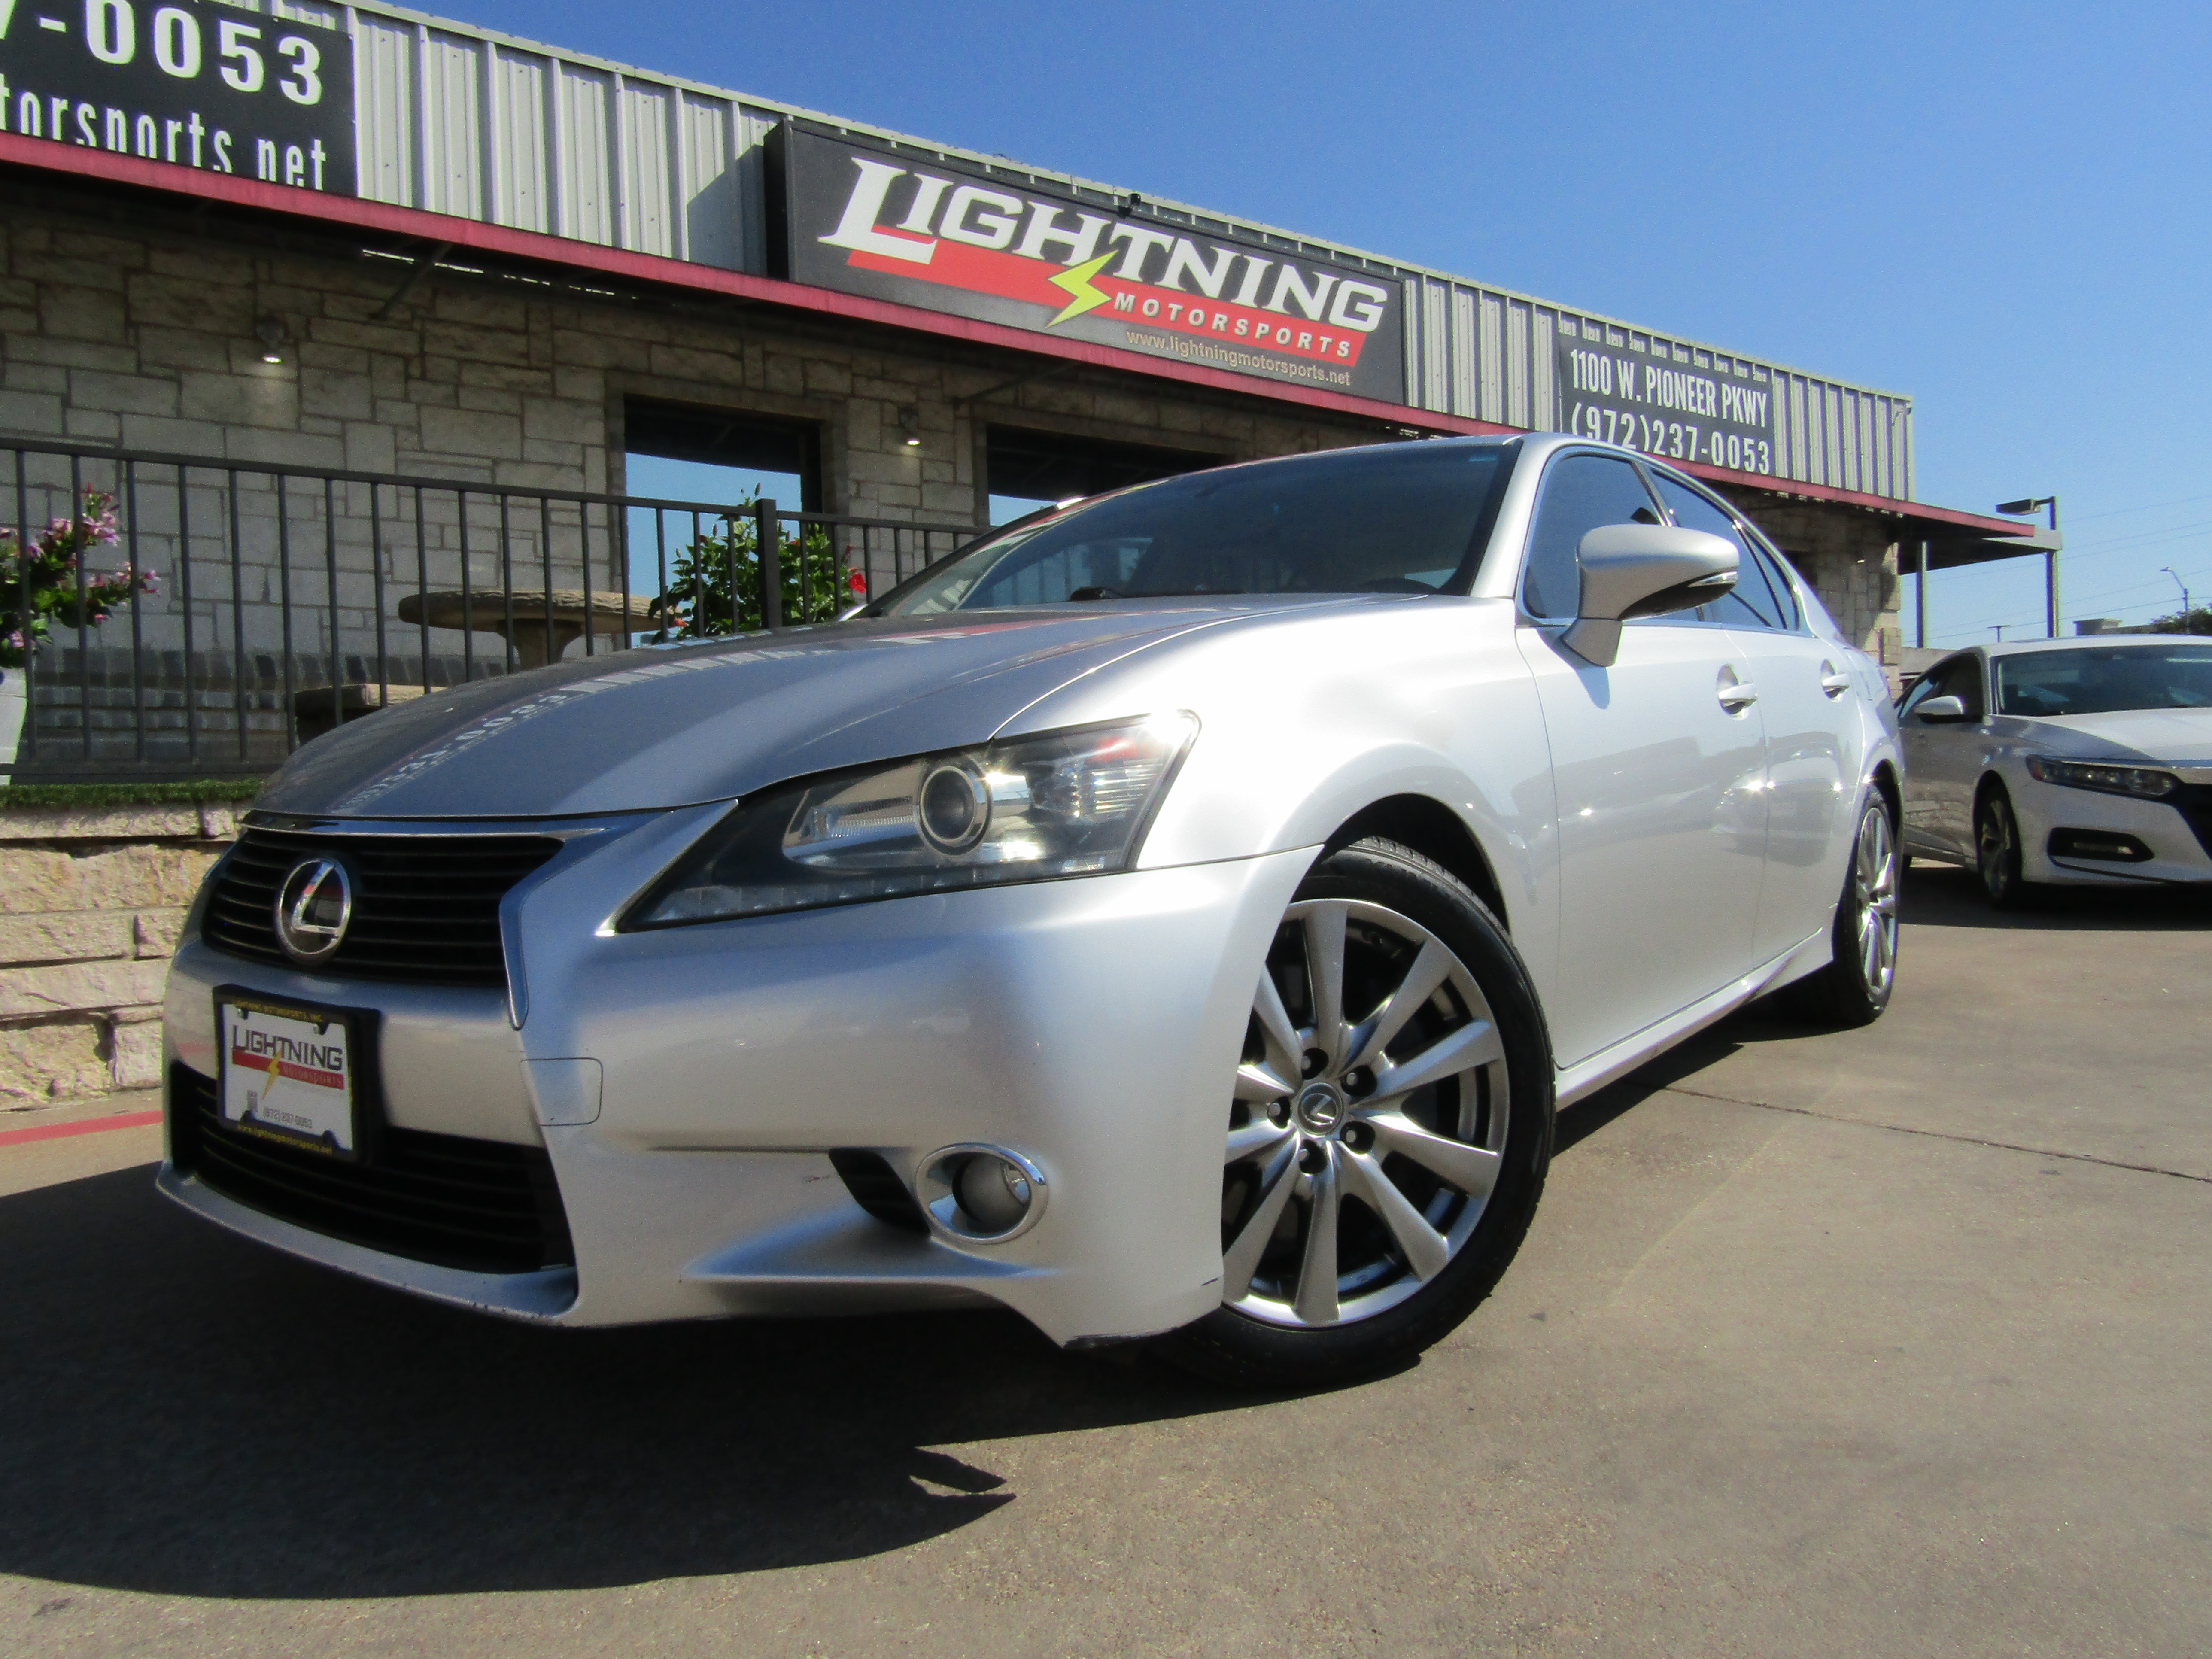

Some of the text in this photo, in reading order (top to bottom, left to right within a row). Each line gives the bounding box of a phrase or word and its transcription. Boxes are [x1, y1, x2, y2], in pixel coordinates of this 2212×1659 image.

[817, 156, 1388, 332] LIGHTNING
[1114, 292, 1351, 358] MOTORSPORTS
[1126, 330, 1351, 386] www.lightningmotorsports.net
[1570, 349, 1768, 428] 1100 W. PIONEER PKWY
[1571, 402, 1770, 475] (972)237-0053
[232, 1024, 343, 1070] LIGHTNING
